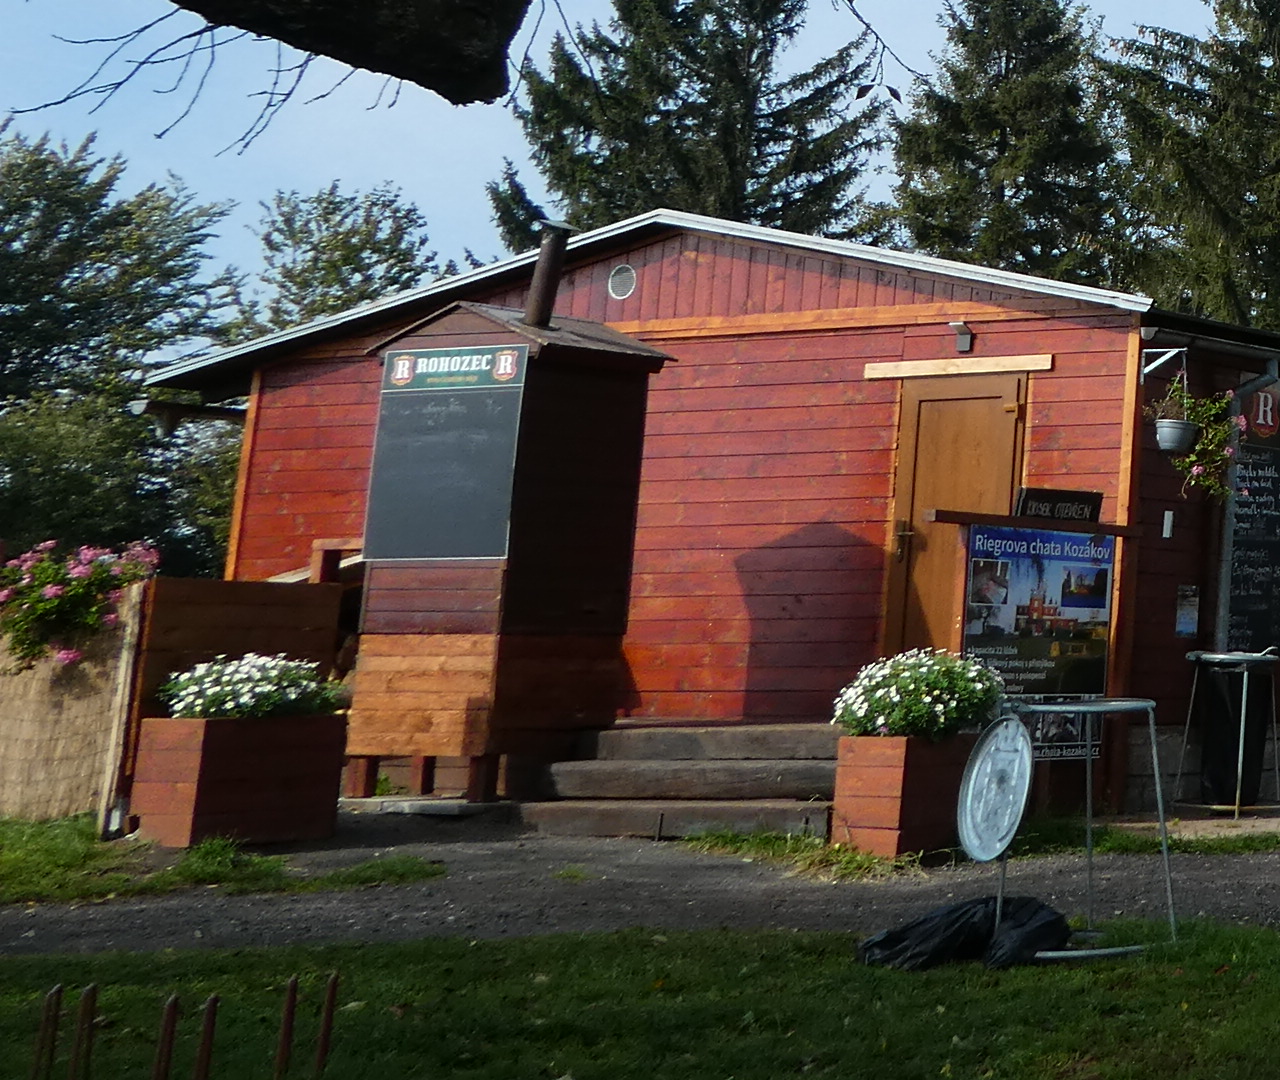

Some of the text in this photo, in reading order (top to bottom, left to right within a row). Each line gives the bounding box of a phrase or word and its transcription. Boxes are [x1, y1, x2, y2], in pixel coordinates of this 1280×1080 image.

[395, 354, 513, 379] R ROHOZEC R
[1256, 392, 1274, 426] R
[975, 534, 1111, 560] Riegrova chata Kozákov
